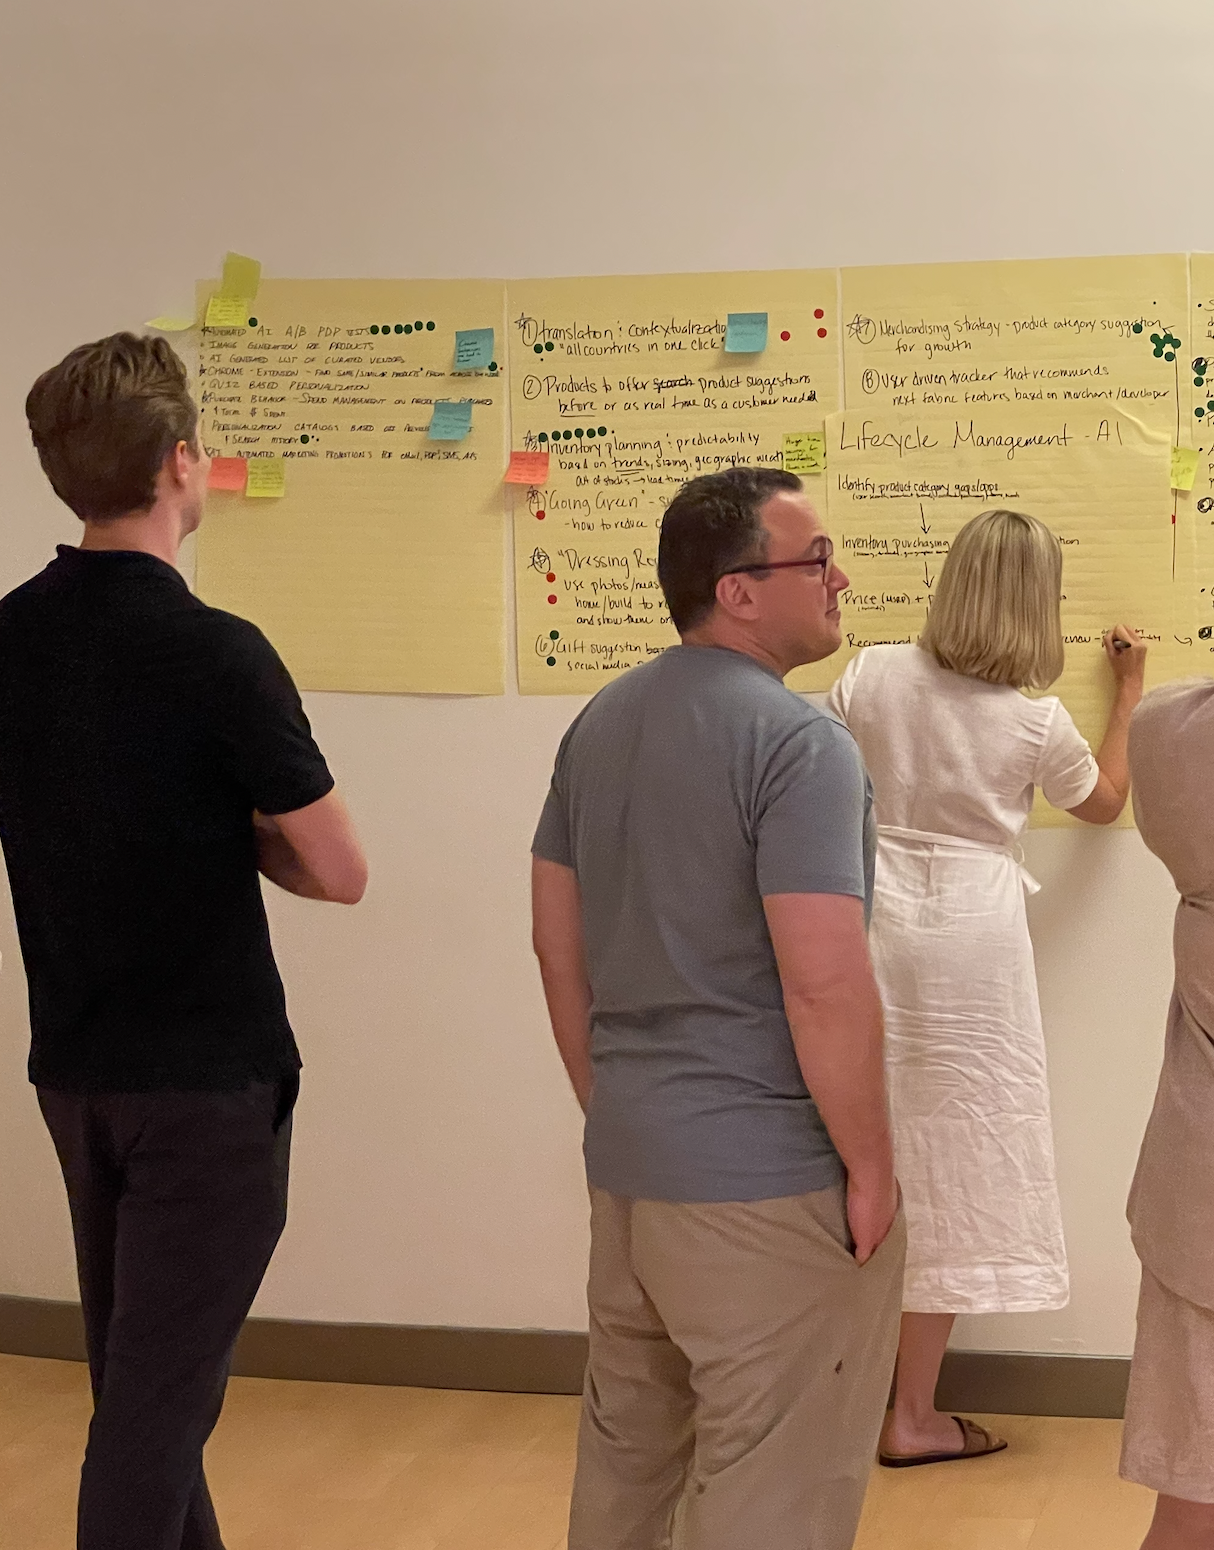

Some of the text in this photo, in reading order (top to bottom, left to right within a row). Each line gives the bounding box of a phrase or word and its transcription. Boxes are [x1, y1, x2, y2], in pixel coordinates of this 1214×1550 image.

[257, 325, 273, 337] AI
[285, 324, 307, 339] A/B
[318, 326, 342, 338] PDP
[629, 318, 726, 338] contextualizatio
[880, 319, 950, 340] Merchandising
[1054, 318, 1096, 334] category
[209, 341, 238, 349] IMAGE
[329, 342, 375, 351] PRODUCTS
[584, 342, 640, 355] countries
[665, 342, 687, 350] one
[896, 338, 971, 359] for growth
[209, 354, 222, 363] AI
[207, 366, 244, 376] CHROME
[257, 368, 299, 377] EXTENSION
[881, 365, 1109, 388] User driven tracker that recommends
[209, 379, 240, 389] QUIZ
[249, 381, 278, 390] BASED
[543, 372, 811, 395] Products to offer product suggestions
[559, 396, 779, 412] before or as real time as a customer
[893, 392, 916, 406] next
[1014, 388, 1043, 400] based
[1047, 391, 1057, 399] on
[605, 436, 662, 458] planning
[676, 432, 760, 453] predictability
[841, 420, 938, 458] Lifecycle
[953, 420, 1073, 460] Management
[559, 458, 588, 469] based
[757, 450, 783, 463] weath
[838, 474, 875, 493] Identify
[878, 481, 911, 494] product
[913, 480, 949, 495] category
[601, 517, 611, 529] to
[614, 518, 648, 528] reduce
[842, 534, 951, 554] Inventory purchasing
[638, 597, 653, 609] to
[841, 590, 877, 605] Price
[576, 615, 595, 625] and
[598, 614, 622, 626] show
[568, 660, 631, 671] social media
